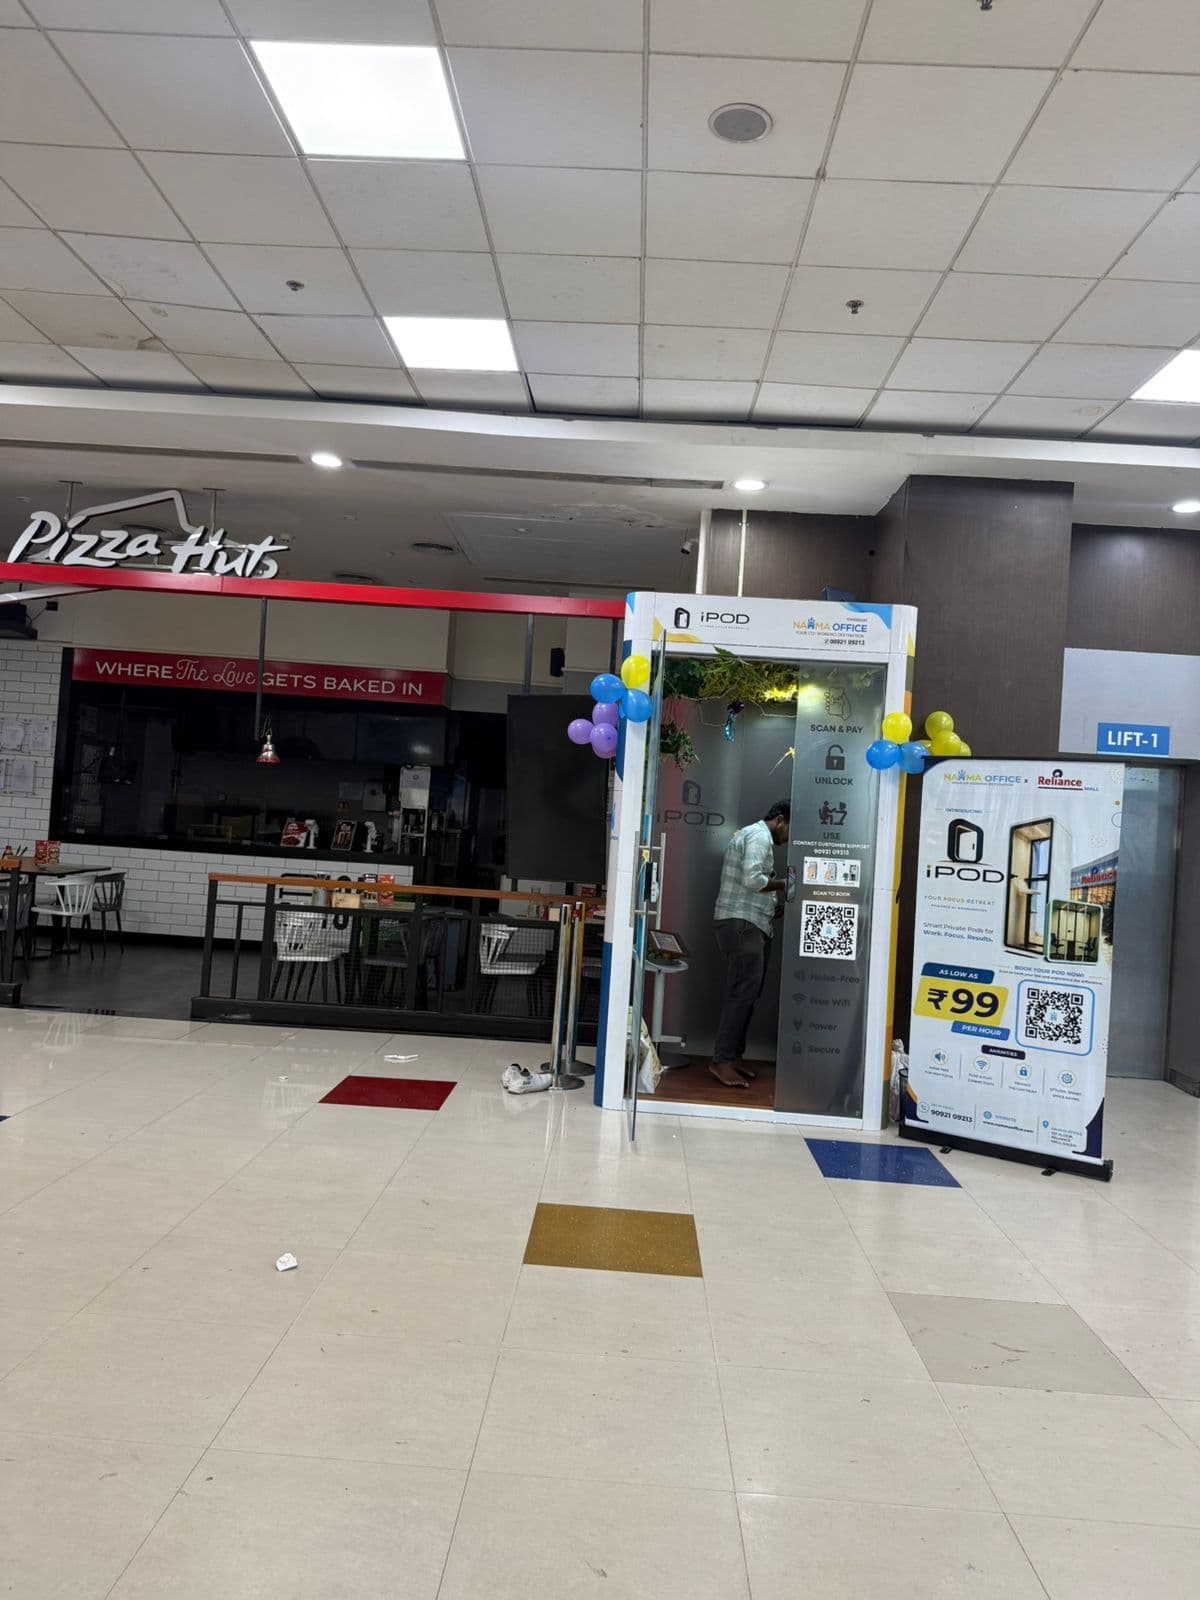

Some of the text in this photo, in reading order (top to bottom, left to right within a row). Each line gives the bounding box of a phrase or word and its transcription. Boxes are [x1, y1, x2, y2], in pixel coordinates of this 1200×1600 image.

[7, 511, 161, 567] Pizza
[701, 612, 750, 624] iPOD
[832, 623, 868, 633] OFFICE
[95, 659, 422, 696] WHERE The Love GETS BAKED IN
[810, 724, 836, 732] SCAN
[838, 725, 844, 733] &
[1107, 730, 1158, 748] LIFT-1
[815, 777, 854, 785] UNLOCK
[984, 775, 1021, 783] OFFICE
[1038, 776, 1082, 787] Reliance
[926, 865, 1004, 883] iPOD
[923, 921, 942, 929] Smart
[923, 929, 994, 942] Work. Focus. Results.
[961, 1024, 1001, 1036] PER HOUR
[930, 1109, 973, 1123] 90921 09213
